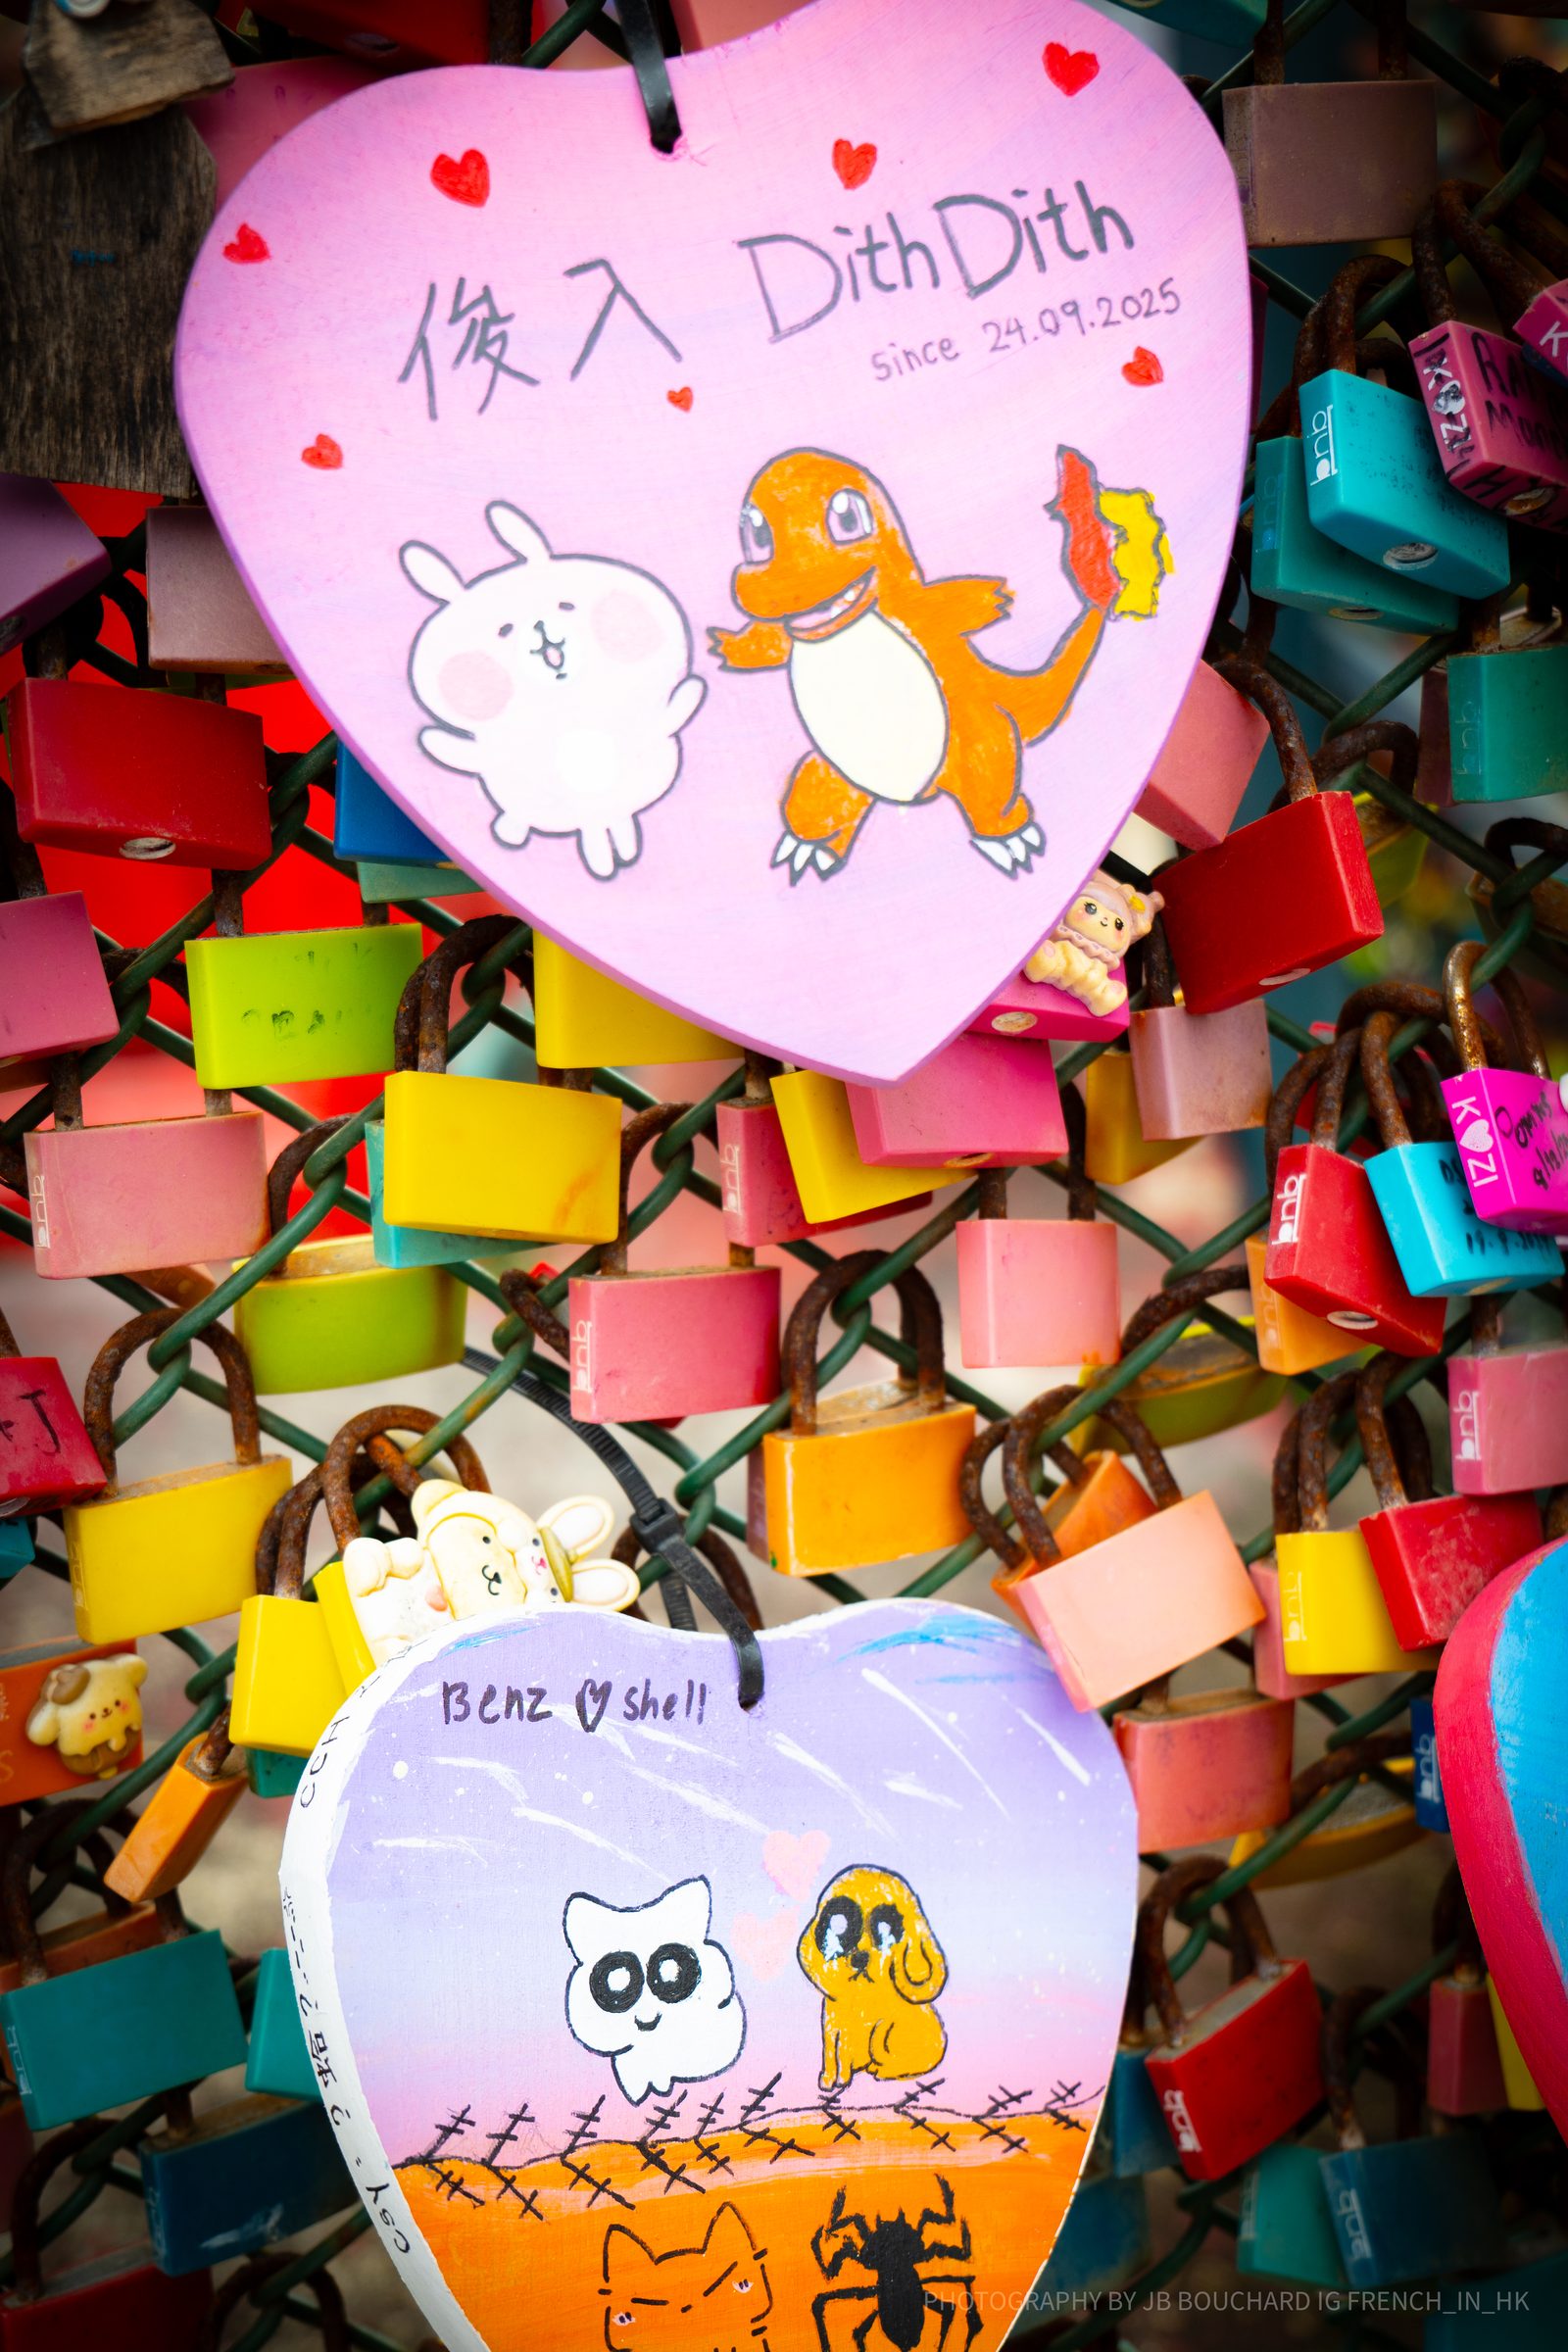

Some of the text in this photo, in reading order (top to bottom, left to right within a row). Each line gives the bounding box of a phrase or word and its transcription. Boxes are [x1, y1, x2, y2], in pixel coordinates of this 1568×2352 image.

[736, 180, 1135, 344] DithDith
[981, 277, 1181, 352] 24.09.2025
[442, 1680, 553, 1725] Benz
